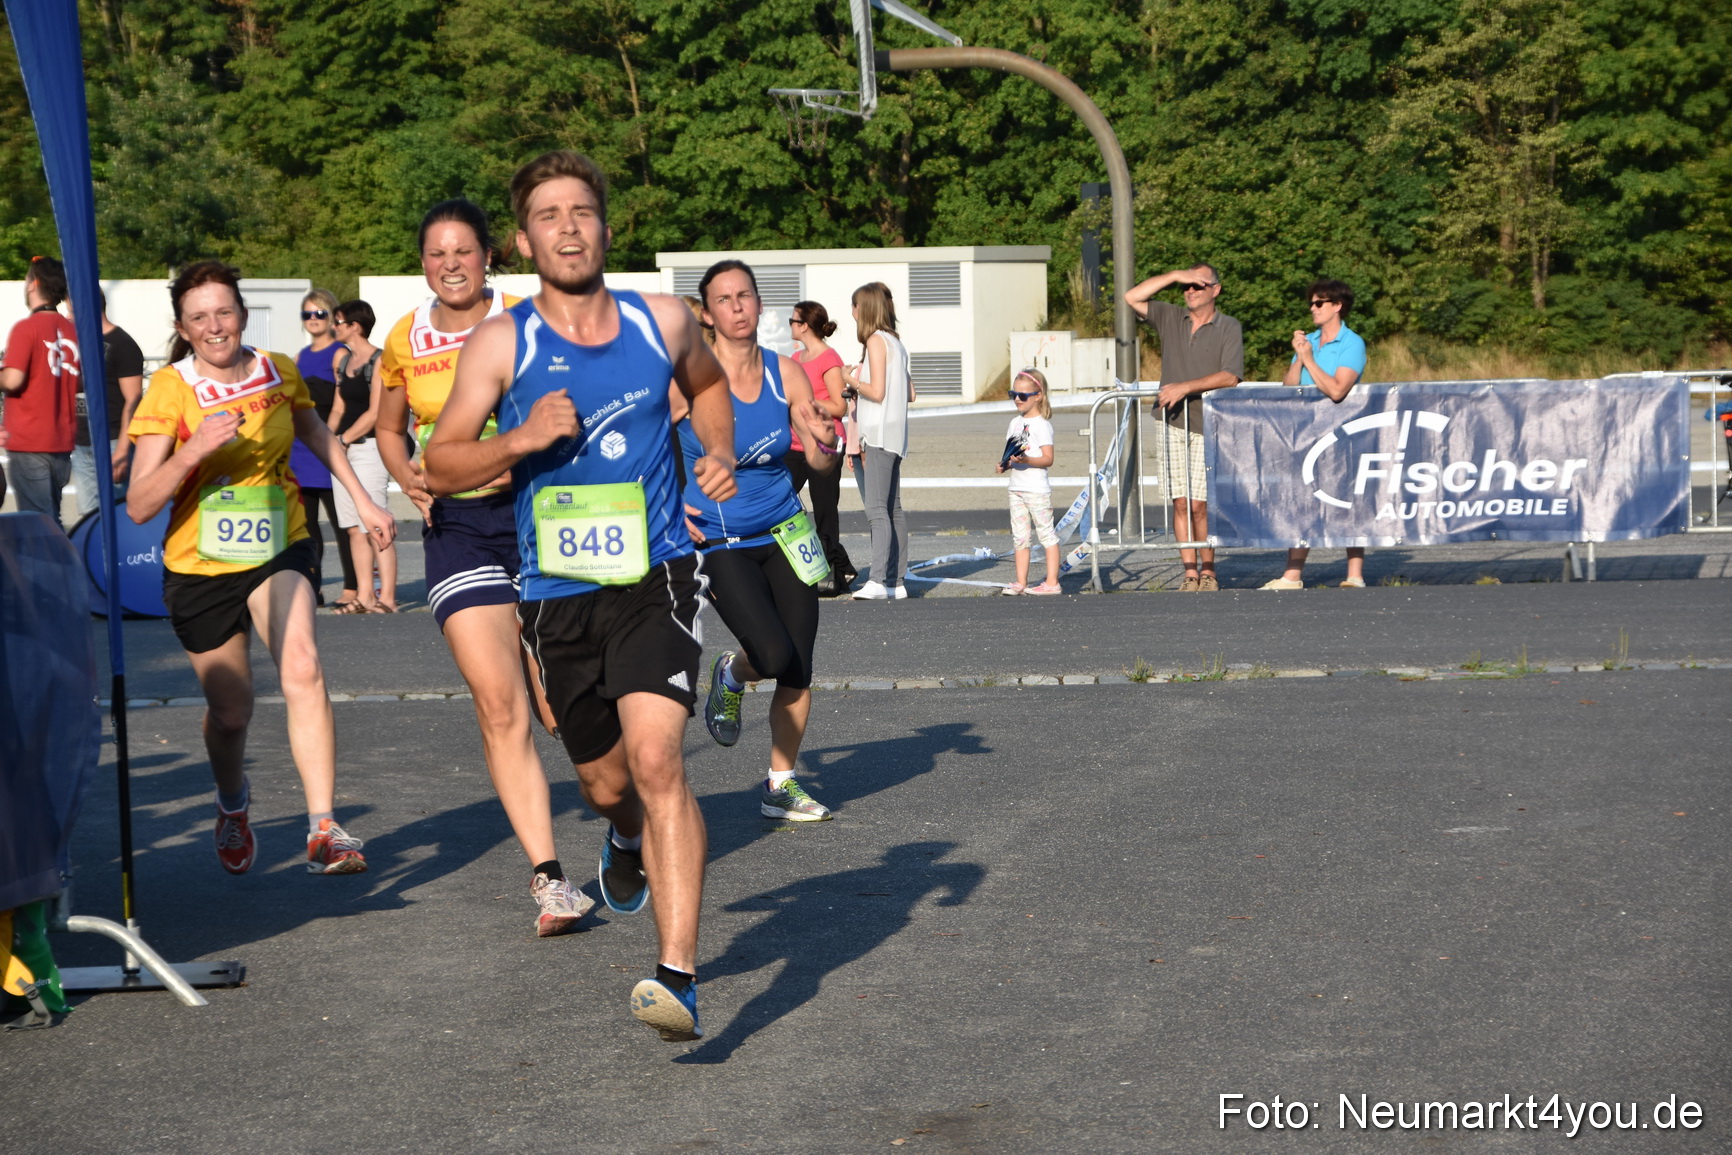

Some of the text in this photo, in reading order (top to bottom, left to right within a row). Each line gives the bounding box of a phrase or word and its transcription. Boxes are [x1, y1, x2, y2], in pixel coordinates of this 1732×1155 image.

[413, 358, 452, 377] MAX
[583, 399, 622, 427] Schick
[623, 387, 650, 402] Bau
[748, 436, 770, 452] Schick
[769, 428, 782, 438] Bau
[1354, 449, 1587, 495] Fischer
[1375, 498, 1568, 520] AUTOMOBILE
[217, 517, 271, 543] 926
[558, 525, 624, 557] 848
[126, 545, 157, 566] und
[563, 563, 589, 571] Claudio
[667, 677, 690, 692] adidas
